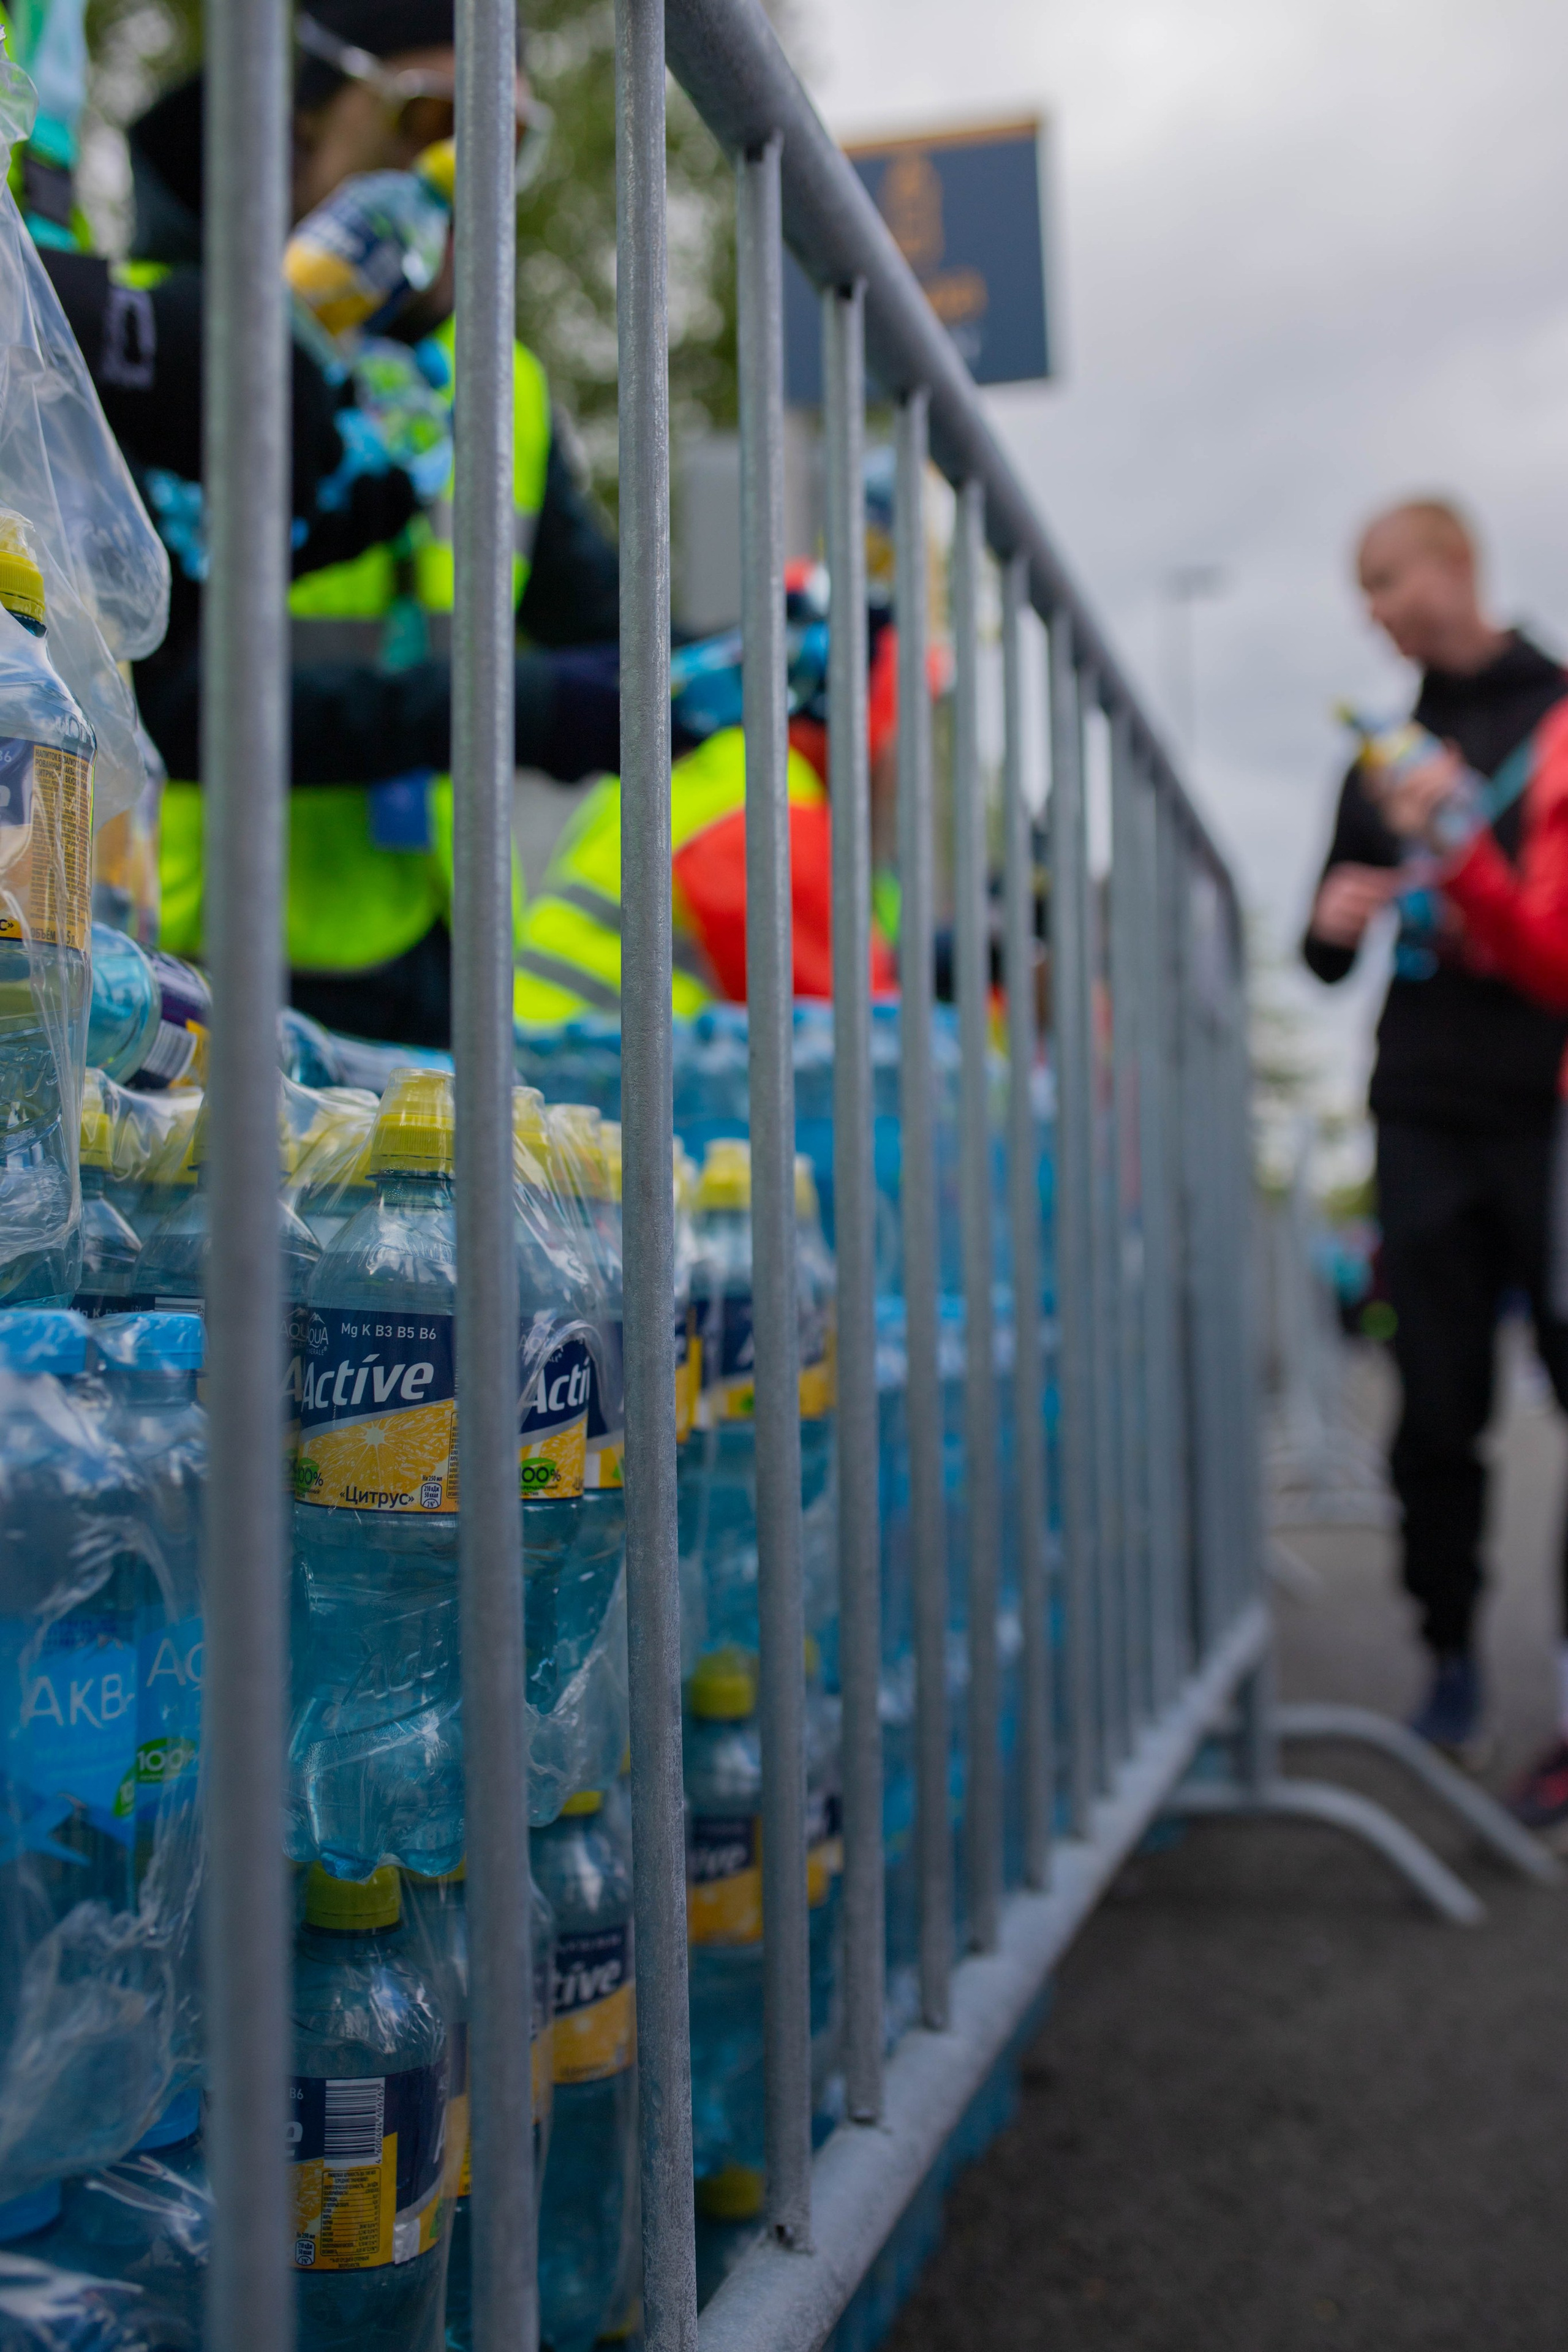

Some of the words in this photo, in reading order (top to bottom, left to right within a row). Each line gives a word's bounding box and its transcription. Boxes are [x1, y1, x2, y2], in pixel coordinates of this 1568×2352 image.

[36, 749, 58, 761] НАПИТОК
[341, 1322, 358, 1338] Mg
[362, 1324, 371, 1336] K
[375, 1325, 392, 1337] B3
[397, 1326, 415, 1338] B5
[420, 1327, 437, 1340] B6
[340, 1486, 415, 1508] «Цитрус»
[290, 2087, 304, 2100] B6
